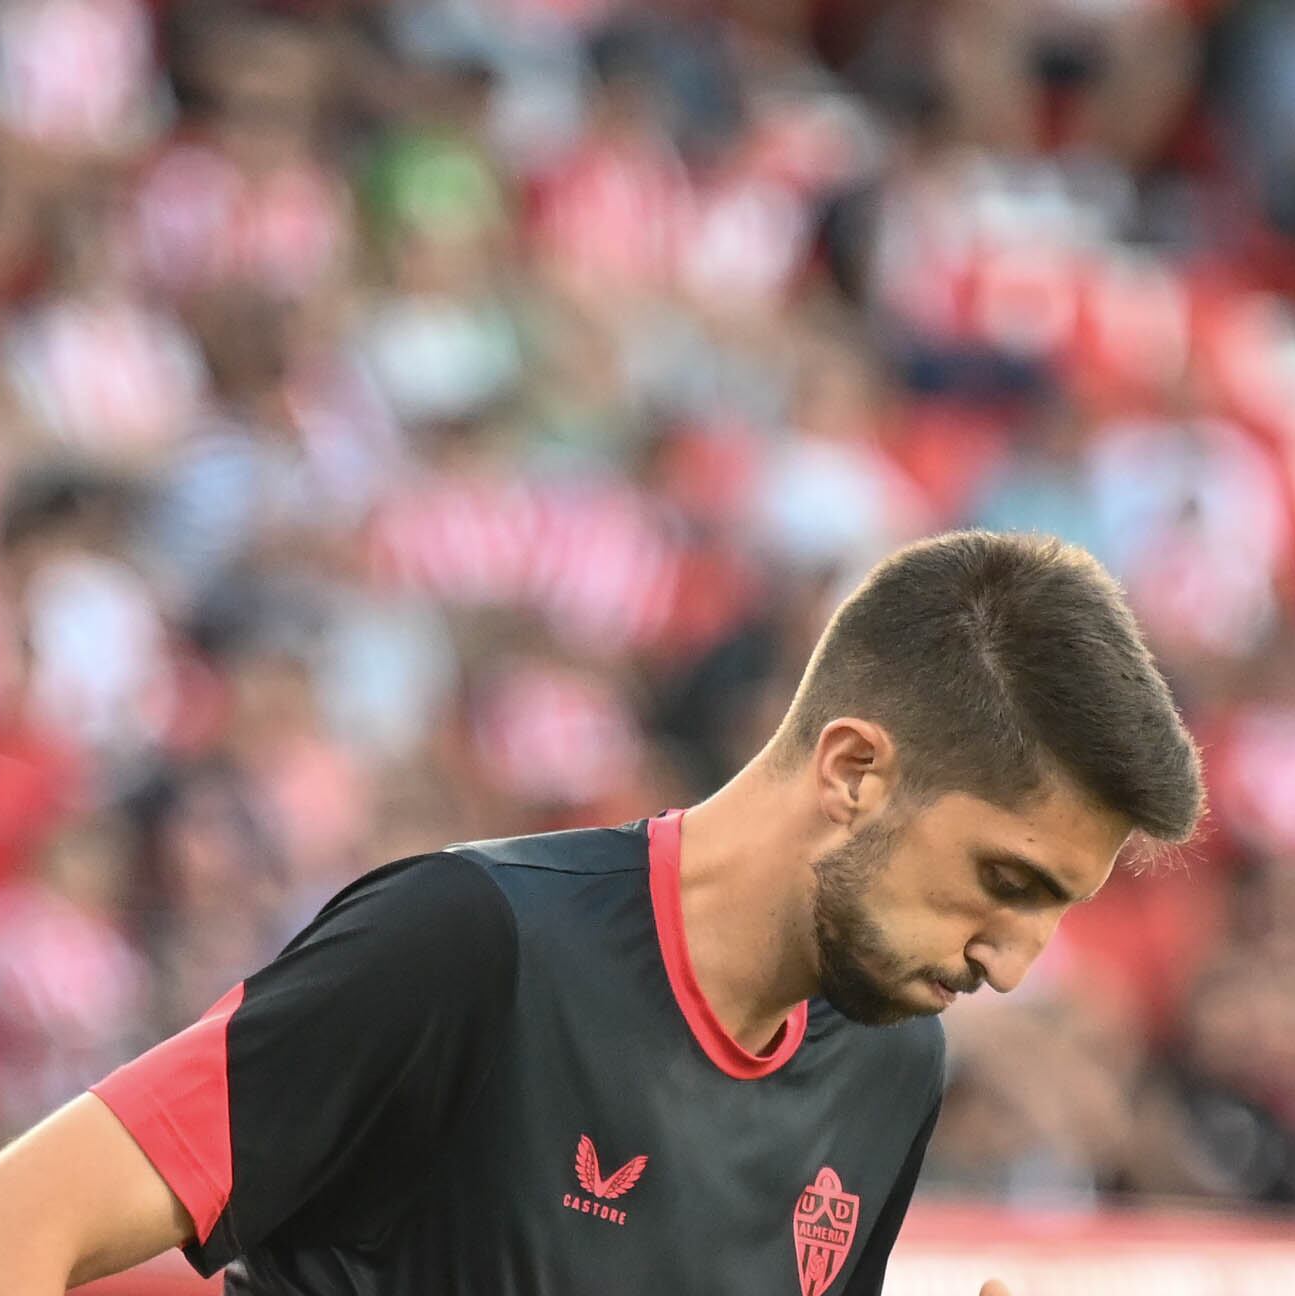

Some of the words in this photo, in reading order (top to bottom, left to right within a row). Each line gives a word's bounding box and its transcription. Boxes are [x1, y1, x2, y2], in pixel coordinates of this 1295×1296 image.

[563, 1194, 627, 1225] CASTORE
[801, 1194, 816, 1213] U
[835, 1202, 851, 1220] D
